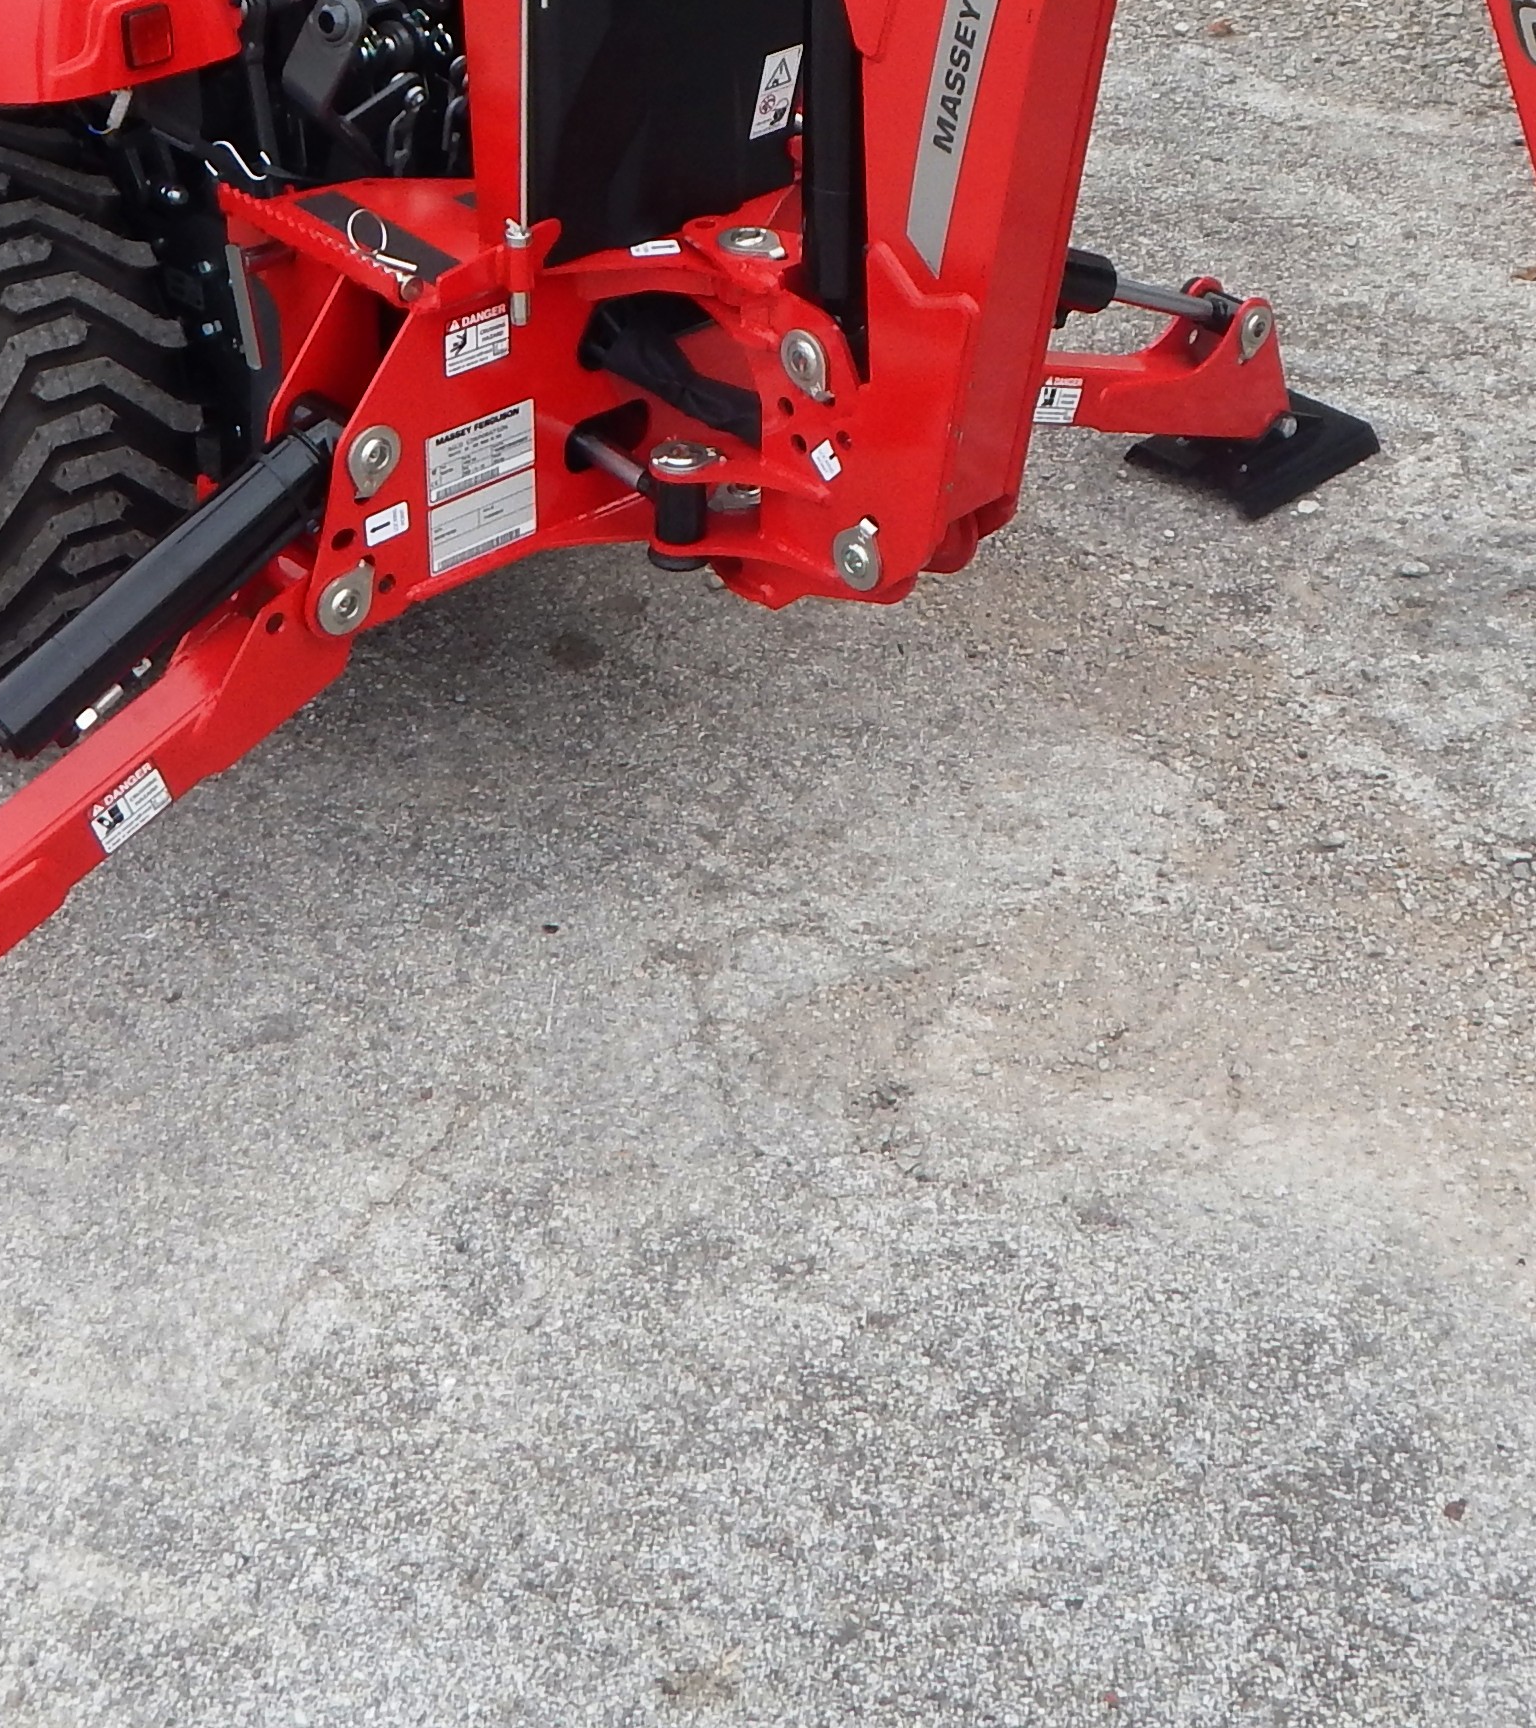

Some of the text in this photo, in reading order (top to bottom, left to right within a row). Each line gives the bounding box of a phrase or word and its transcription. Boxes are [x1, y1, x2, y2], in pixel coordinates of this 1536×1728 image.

[461, 303, 506, 328] DANGER
[435, 407, 520, 446] MASSEY FERGUSON
[104, 762, 152, 806] DANGER
